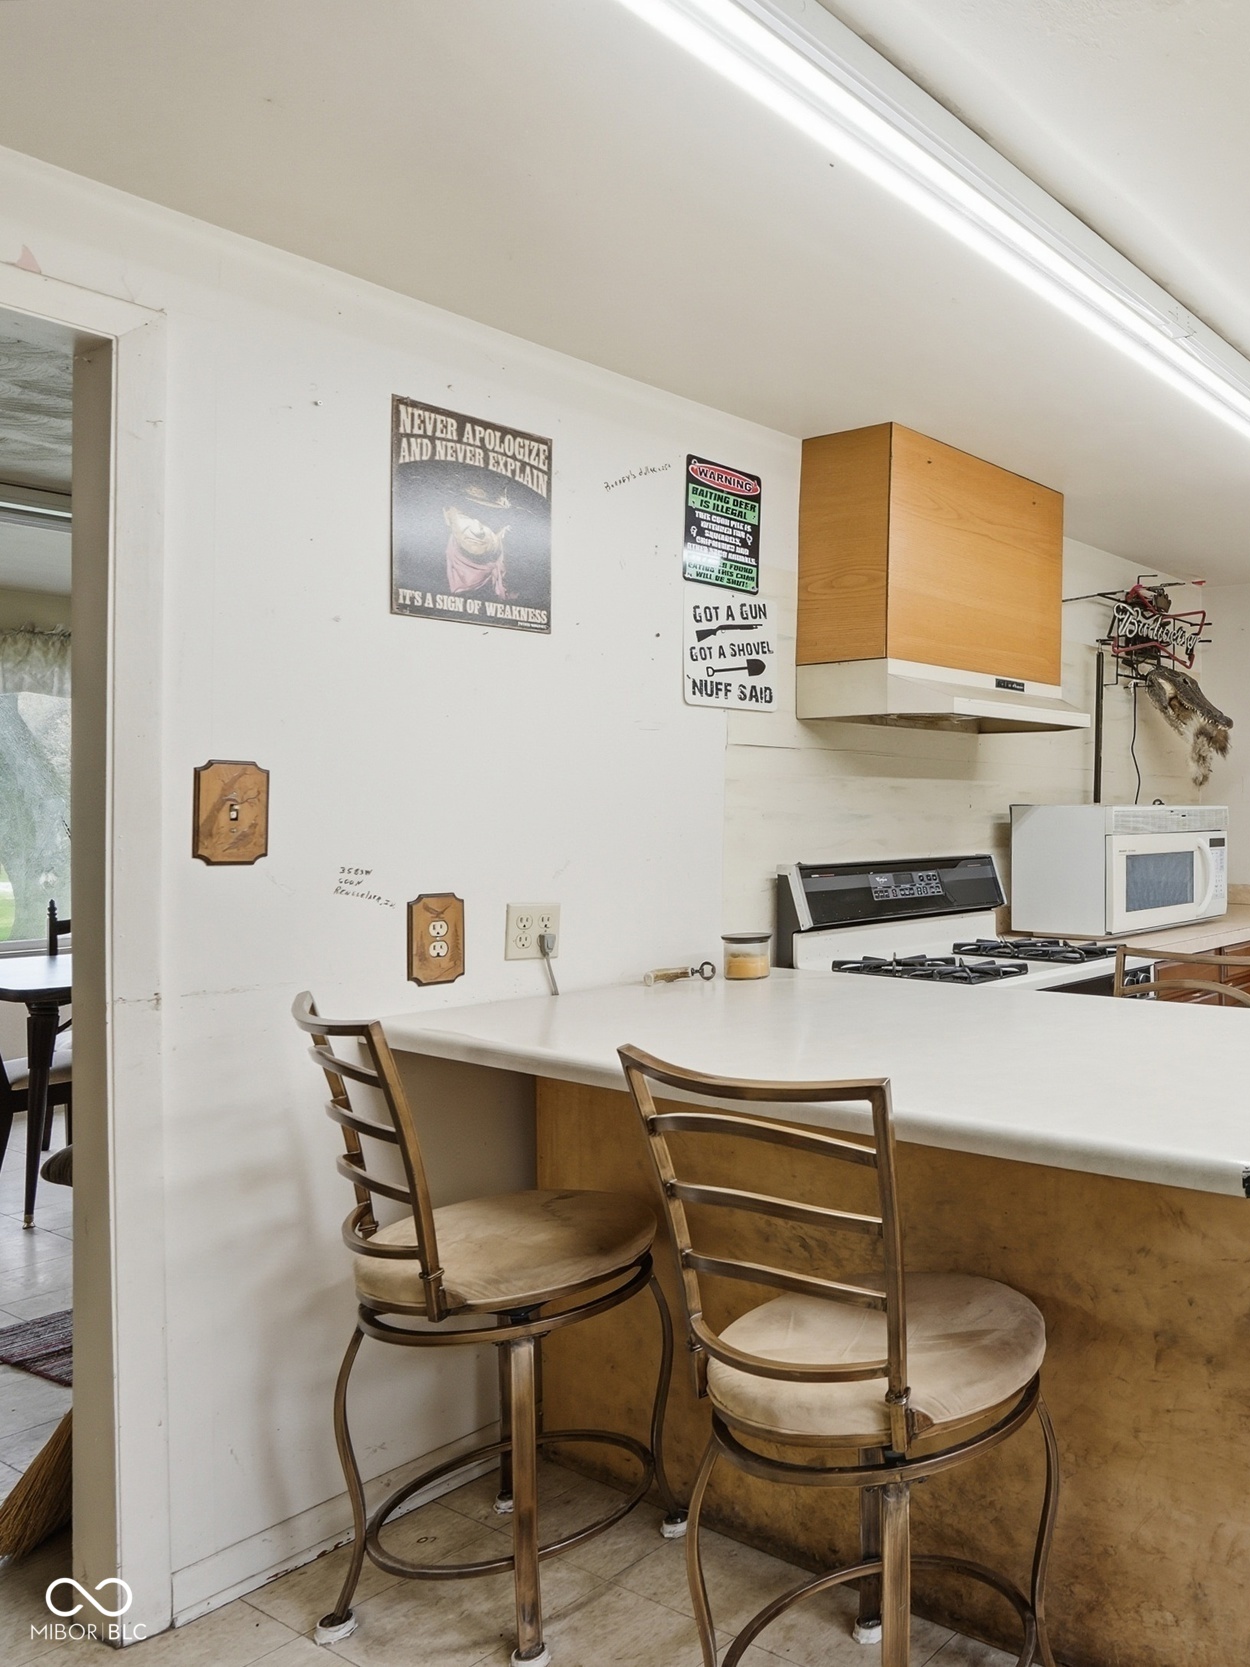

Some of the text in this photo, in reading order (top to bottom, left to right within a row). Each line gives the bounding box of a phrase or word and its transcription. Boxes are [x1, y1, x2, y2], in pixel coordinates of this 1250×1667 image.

[399, 404, 548, 472] NEVER APOLOGIZE
[399, 437, 548, 499] AND NEVER EXPLAIN
[698, 467, 753, 492] WARNING
[692, 486, 757, 513] BAITING DEER
[700, 499, 748, 520] IS ILLEGAL
[398, 588, 548, 624] IT'S A SIGN OF WEAKNESS
[693, 603, 767, 623] GOT A GUN
[689, 641, 774, 662] GOT A SHOVEL
[737, 683, 773, 704] SAID
